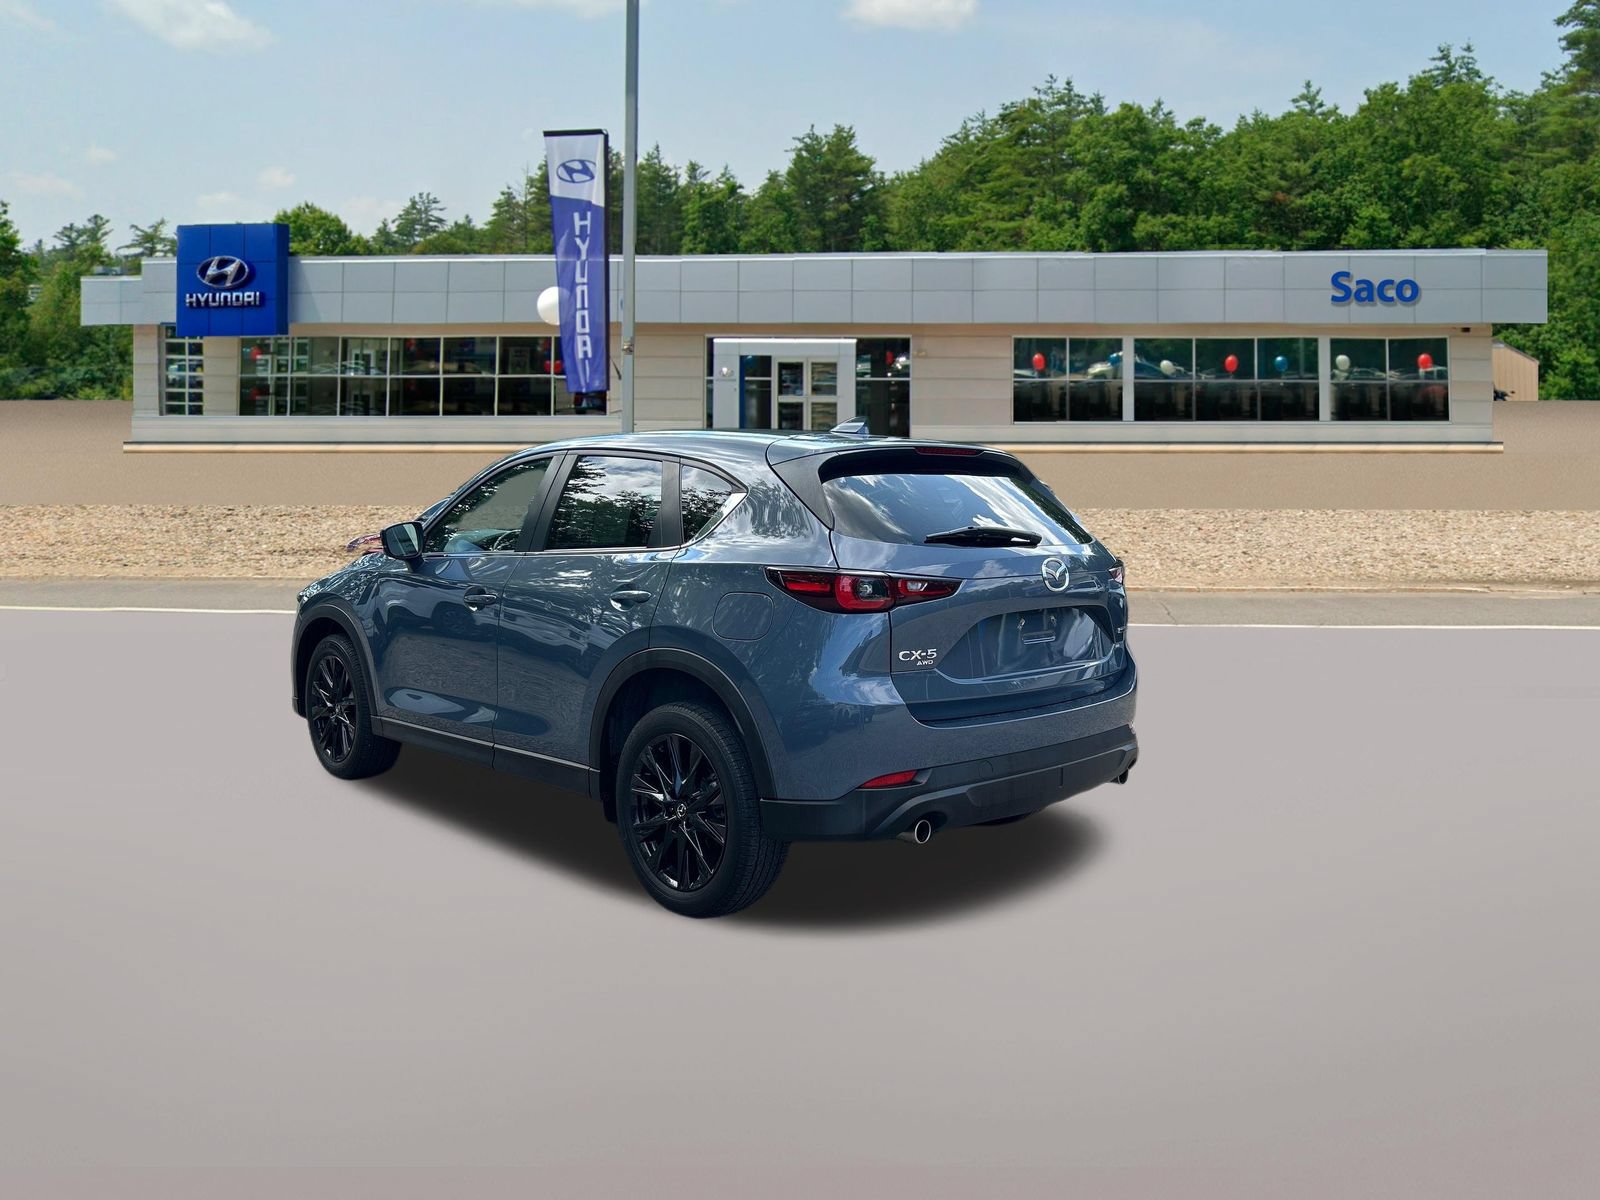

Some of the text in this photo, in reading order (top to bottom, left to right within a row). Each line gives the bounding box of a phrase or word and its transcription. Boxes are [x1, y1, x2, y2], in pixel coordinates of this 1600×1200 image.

[573, 211, 592, 383] HYUNDAI
[1330, 270, 1420, 303] Saco
[185, 291, 261, 308] HYUNDAI
[898, 648, 938, 661] CX-5
